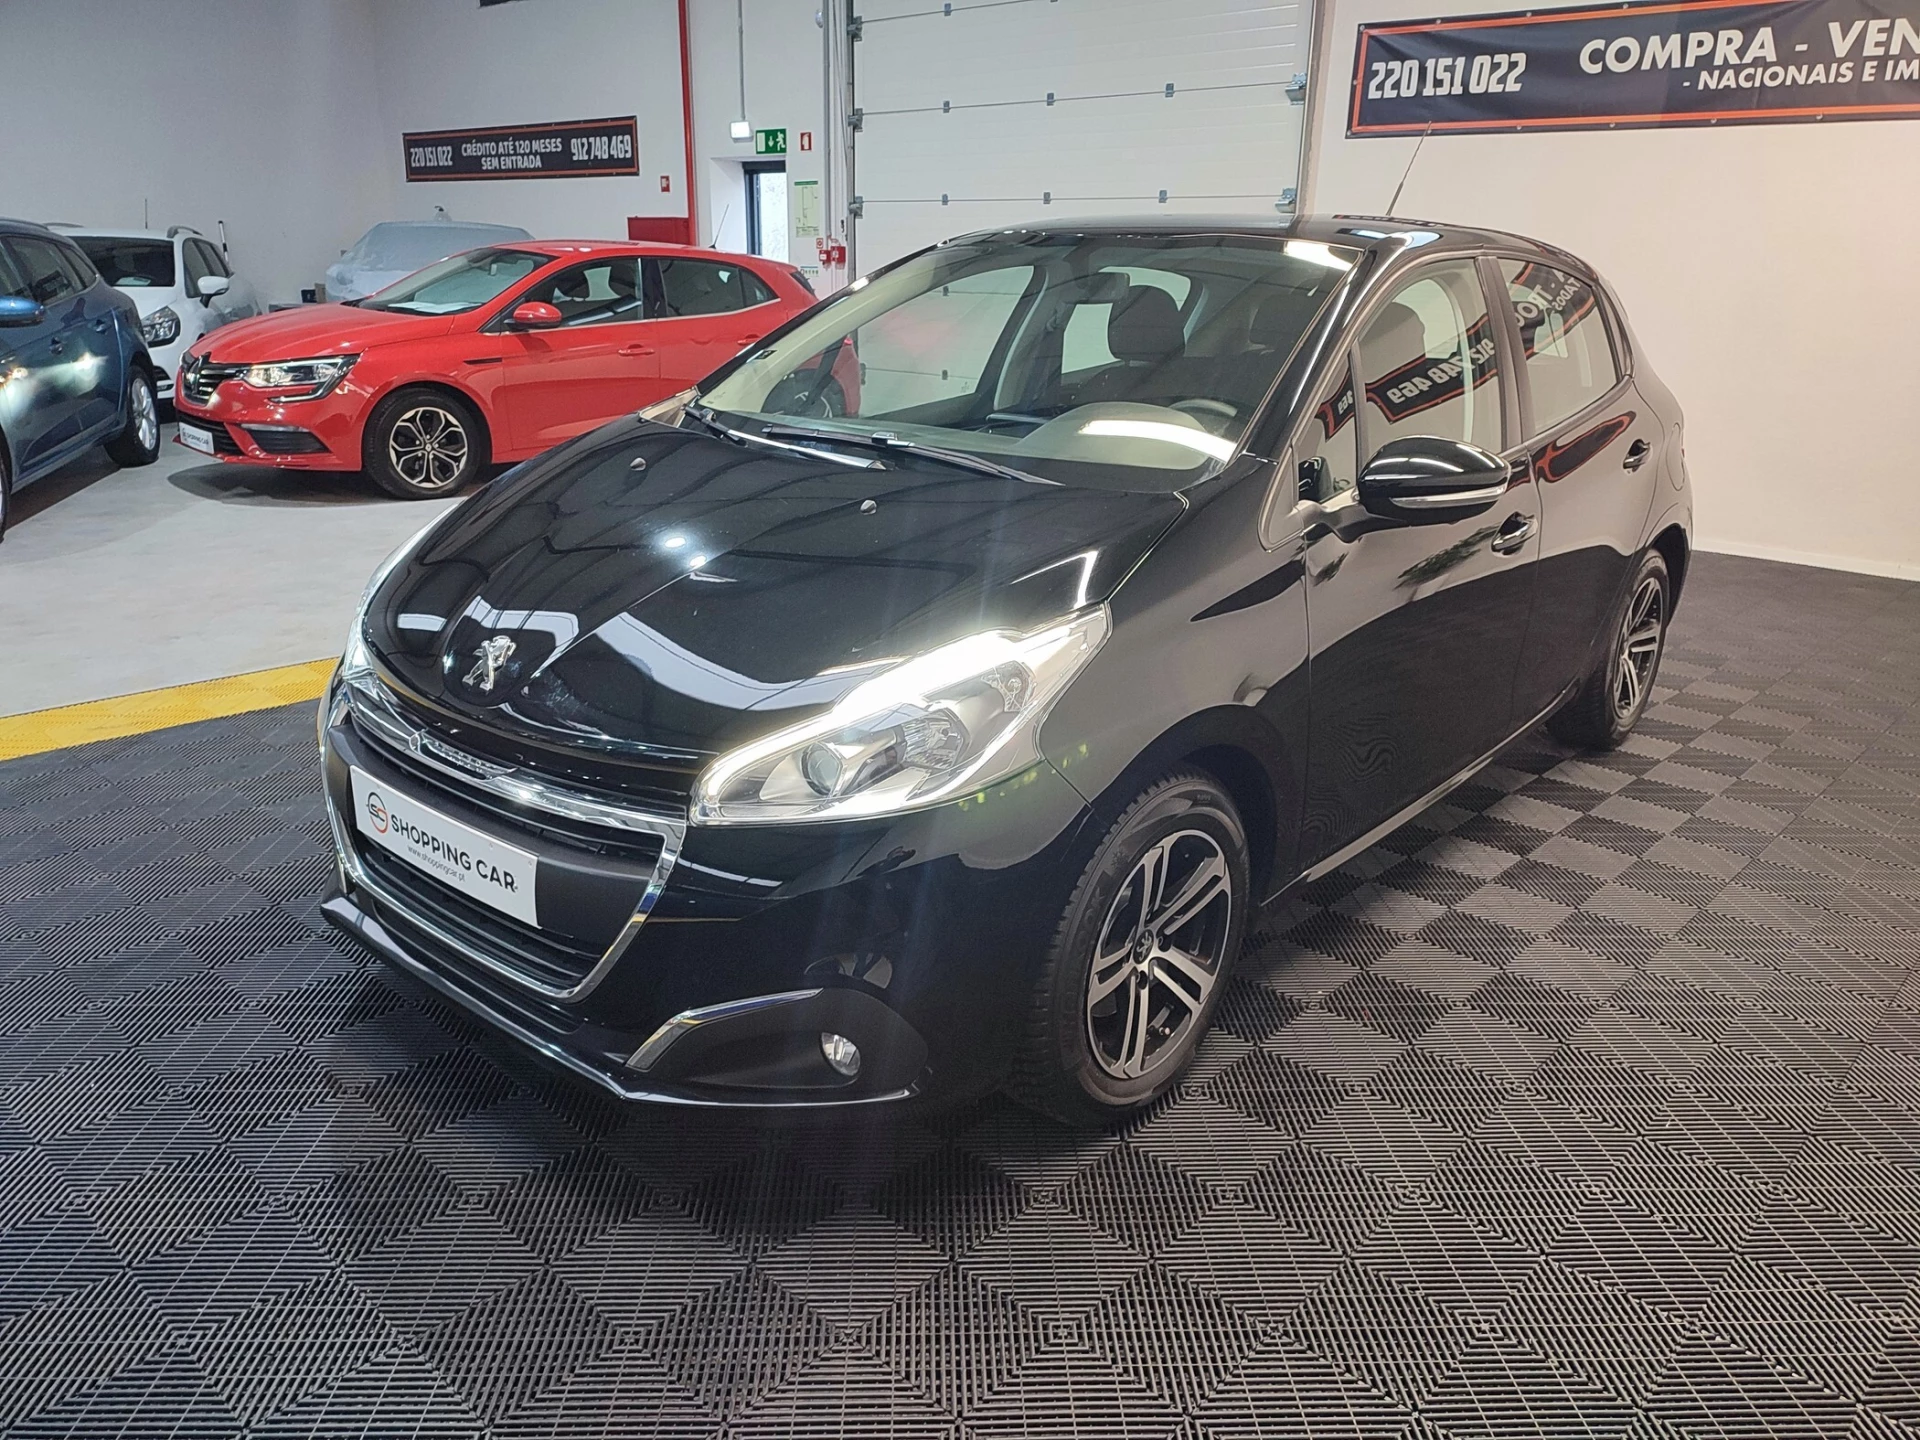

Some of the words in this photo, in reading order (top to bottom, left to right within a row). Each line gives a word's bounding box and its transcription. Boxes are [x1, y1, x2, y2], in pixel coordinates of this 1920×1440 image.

[1579, 26, 1777, 74] COMPRA
[1828, 18, 1920, 58] VEN
[1367, 59, 1420, 100] 220
[1422, 56, 1467, 97] 151
[1468, 52, 1527, 95] 022
[1697, 61, 1854, 90] NACIONAIS
[1861, 60, 1879, 82] E
[1885, 59, 1920, 81] IM
[410, 147, 425, 168] 220
[425, 146, 437, 166] 151
[437, 145, 453, 166] 022
[461, 139, 496, 157] CRÉDITO
[498, 137, 515, 155] ATÉ
[515, 140, 531, 154] 120
[531, 138, 562, 153] MESES
[571, 137, 589, 161] 912
[589, 135, 609, 160] 748
[610, 134, 632, 159] 469
[481, 156, 500, 170] SEM
[500, 154, 542, 170] ENTRADA
[391, 814, 471, 871] SHOPPING
[476, 859, 516, 893] CAR
